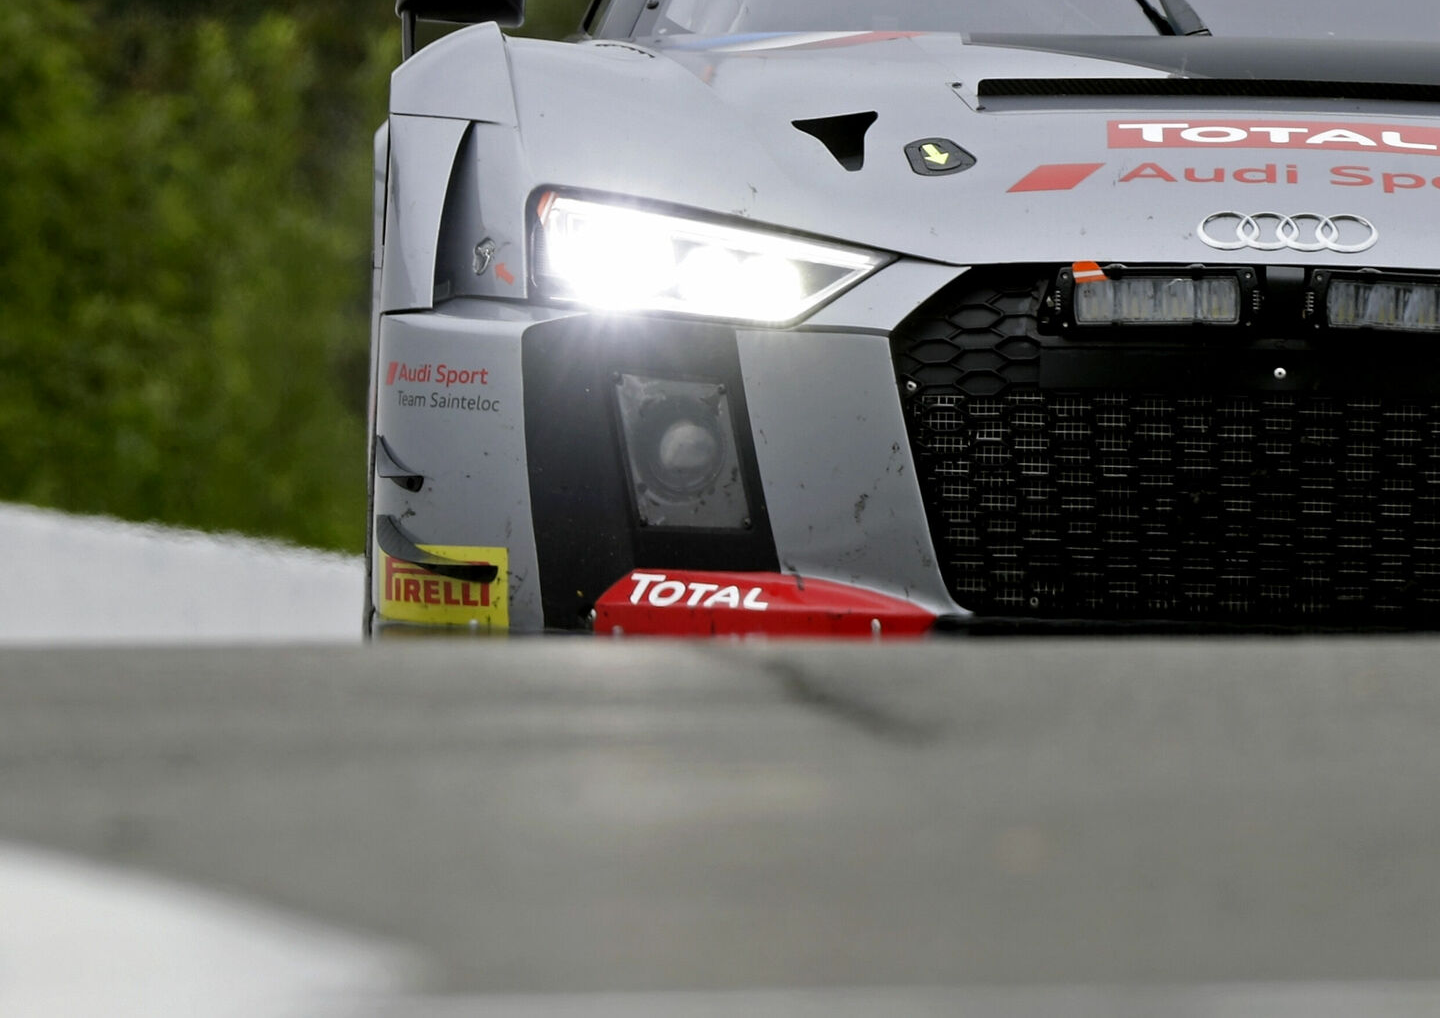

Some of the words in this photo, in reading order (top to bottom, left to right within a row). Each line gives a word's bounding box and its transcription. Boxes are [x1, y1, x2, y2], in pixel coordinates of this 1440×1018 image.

[1118, 122, 1438, 151] TOTAL
[1117, 161, 1299, 185] Audi
[398, 363, 432, 383] Audi
[434, 364, 489, 387] Sport
[398, 390, 426, 407] Team
[429, 392, 501, 412] Sainteloc
[385, 555, 490, 608] PIRELLI
[629, 572, 769, 611] TOTAL
